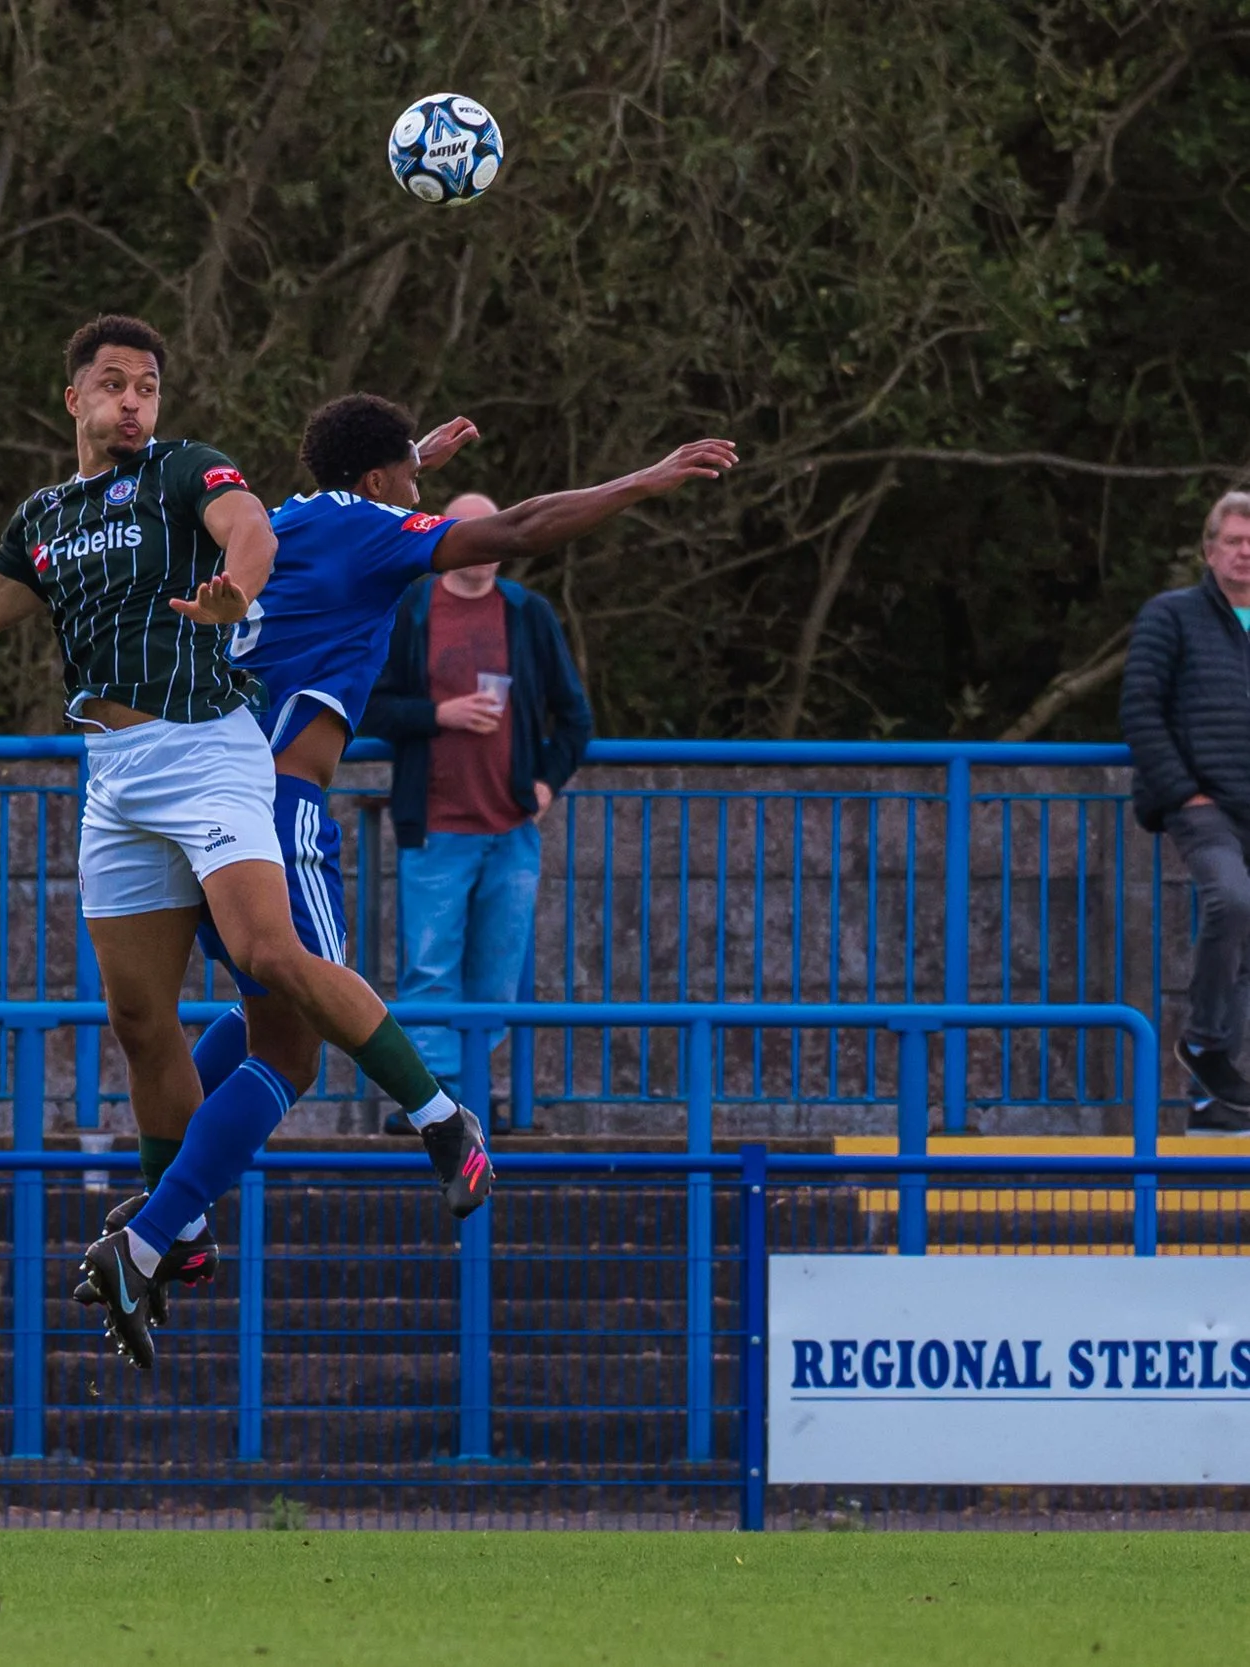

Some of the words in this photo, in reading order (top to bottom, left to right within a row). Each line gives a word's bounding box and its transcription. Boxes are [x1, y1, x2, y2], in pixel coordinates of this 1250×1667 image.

[49, 520, 143, 567] Fidelis
[791, 1339, 1052, 1390] REGIONAL
[1068, 1339, 1250, 1390] STEELS
